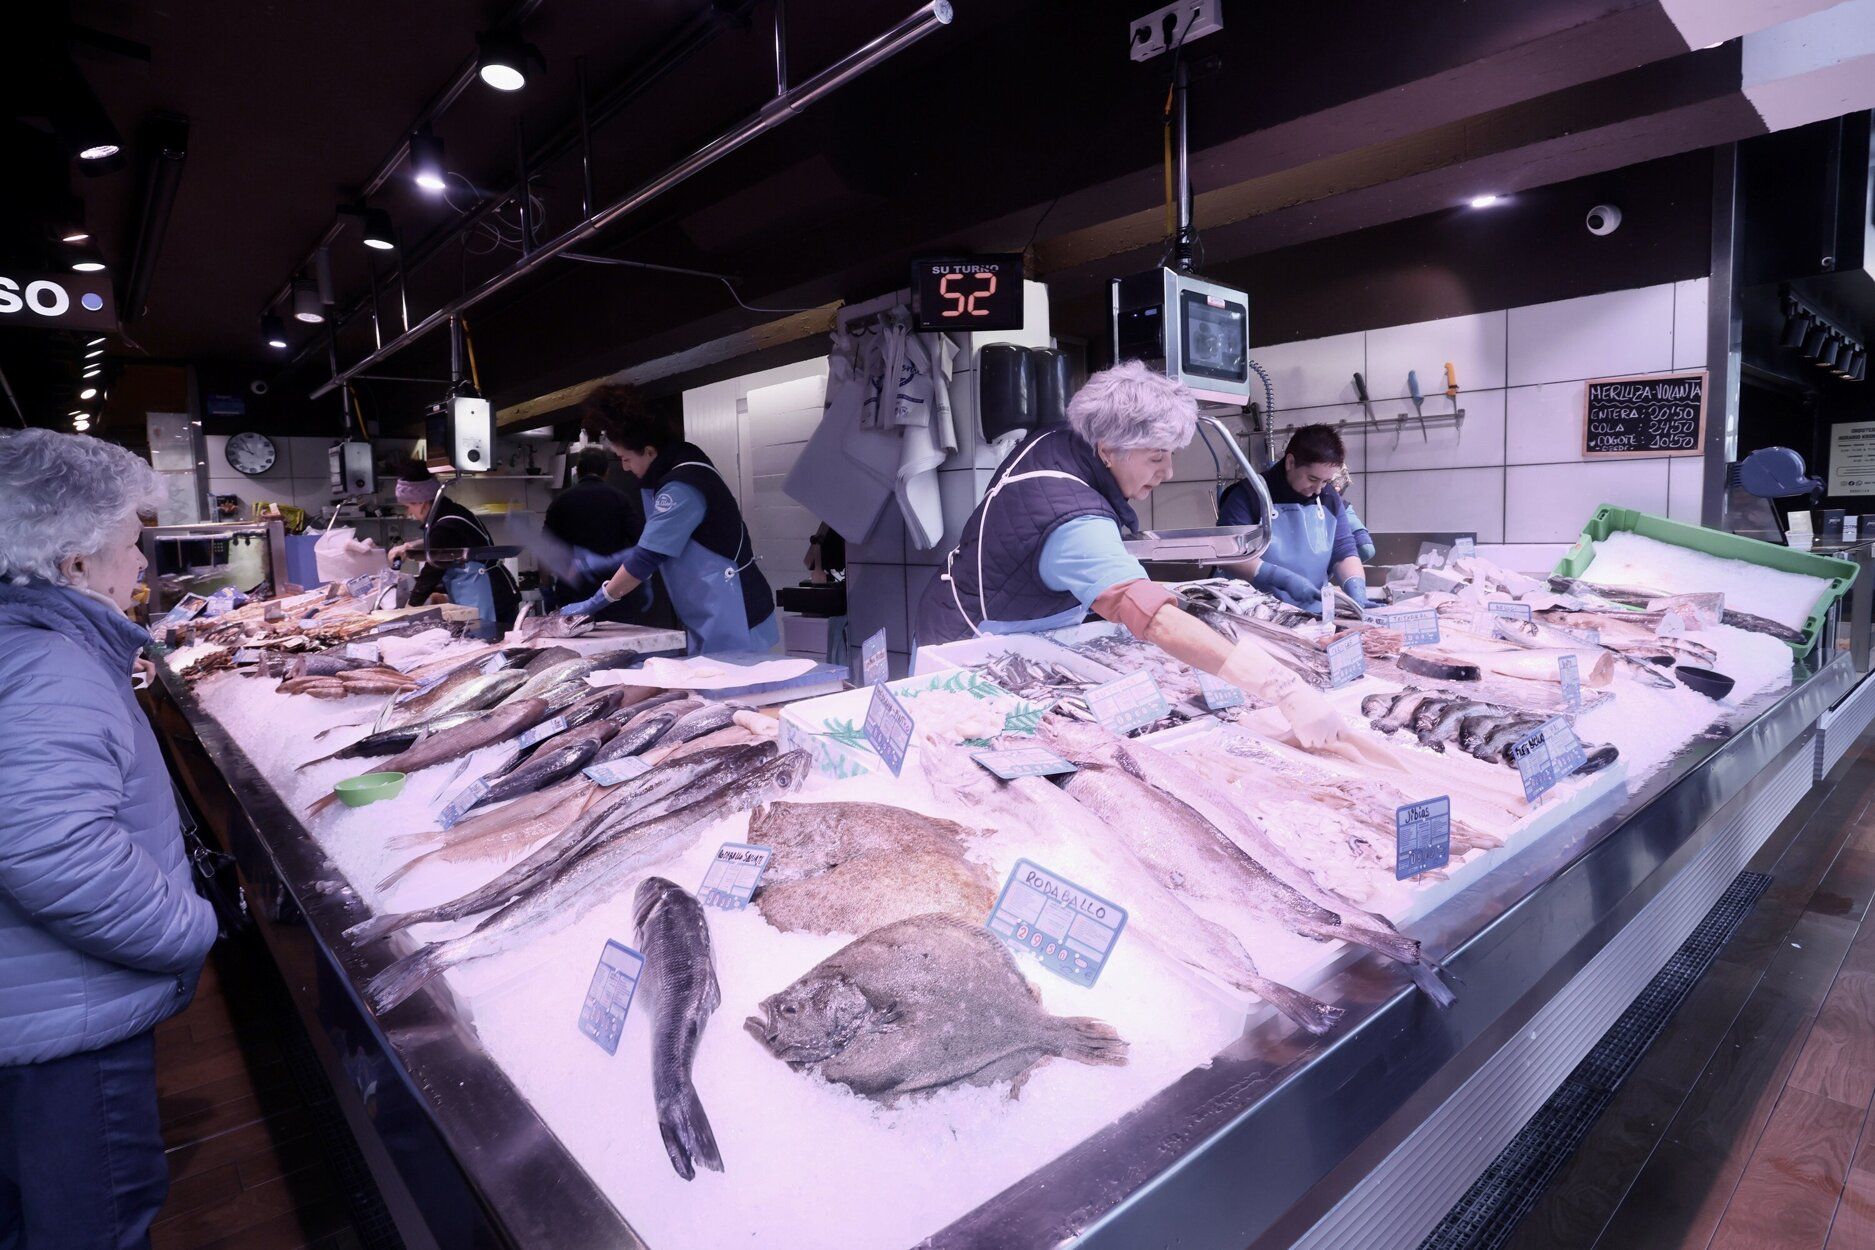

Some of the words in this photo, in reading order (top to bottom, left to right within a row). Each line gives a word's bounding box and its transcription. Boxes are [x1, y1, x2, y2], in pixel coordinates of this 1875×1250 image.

[932, 266, 950, 274] SU
[953, 264, 999, 273] TURNO
[939, 272, 997, 317] 52
[1648, 406, 1694, 421] 20'50
[1591, 422, 1625, 433] COLA
[1648, 420, 1695, 435] 24'50
[1025, 870, 1106, 919] RODABALLO
